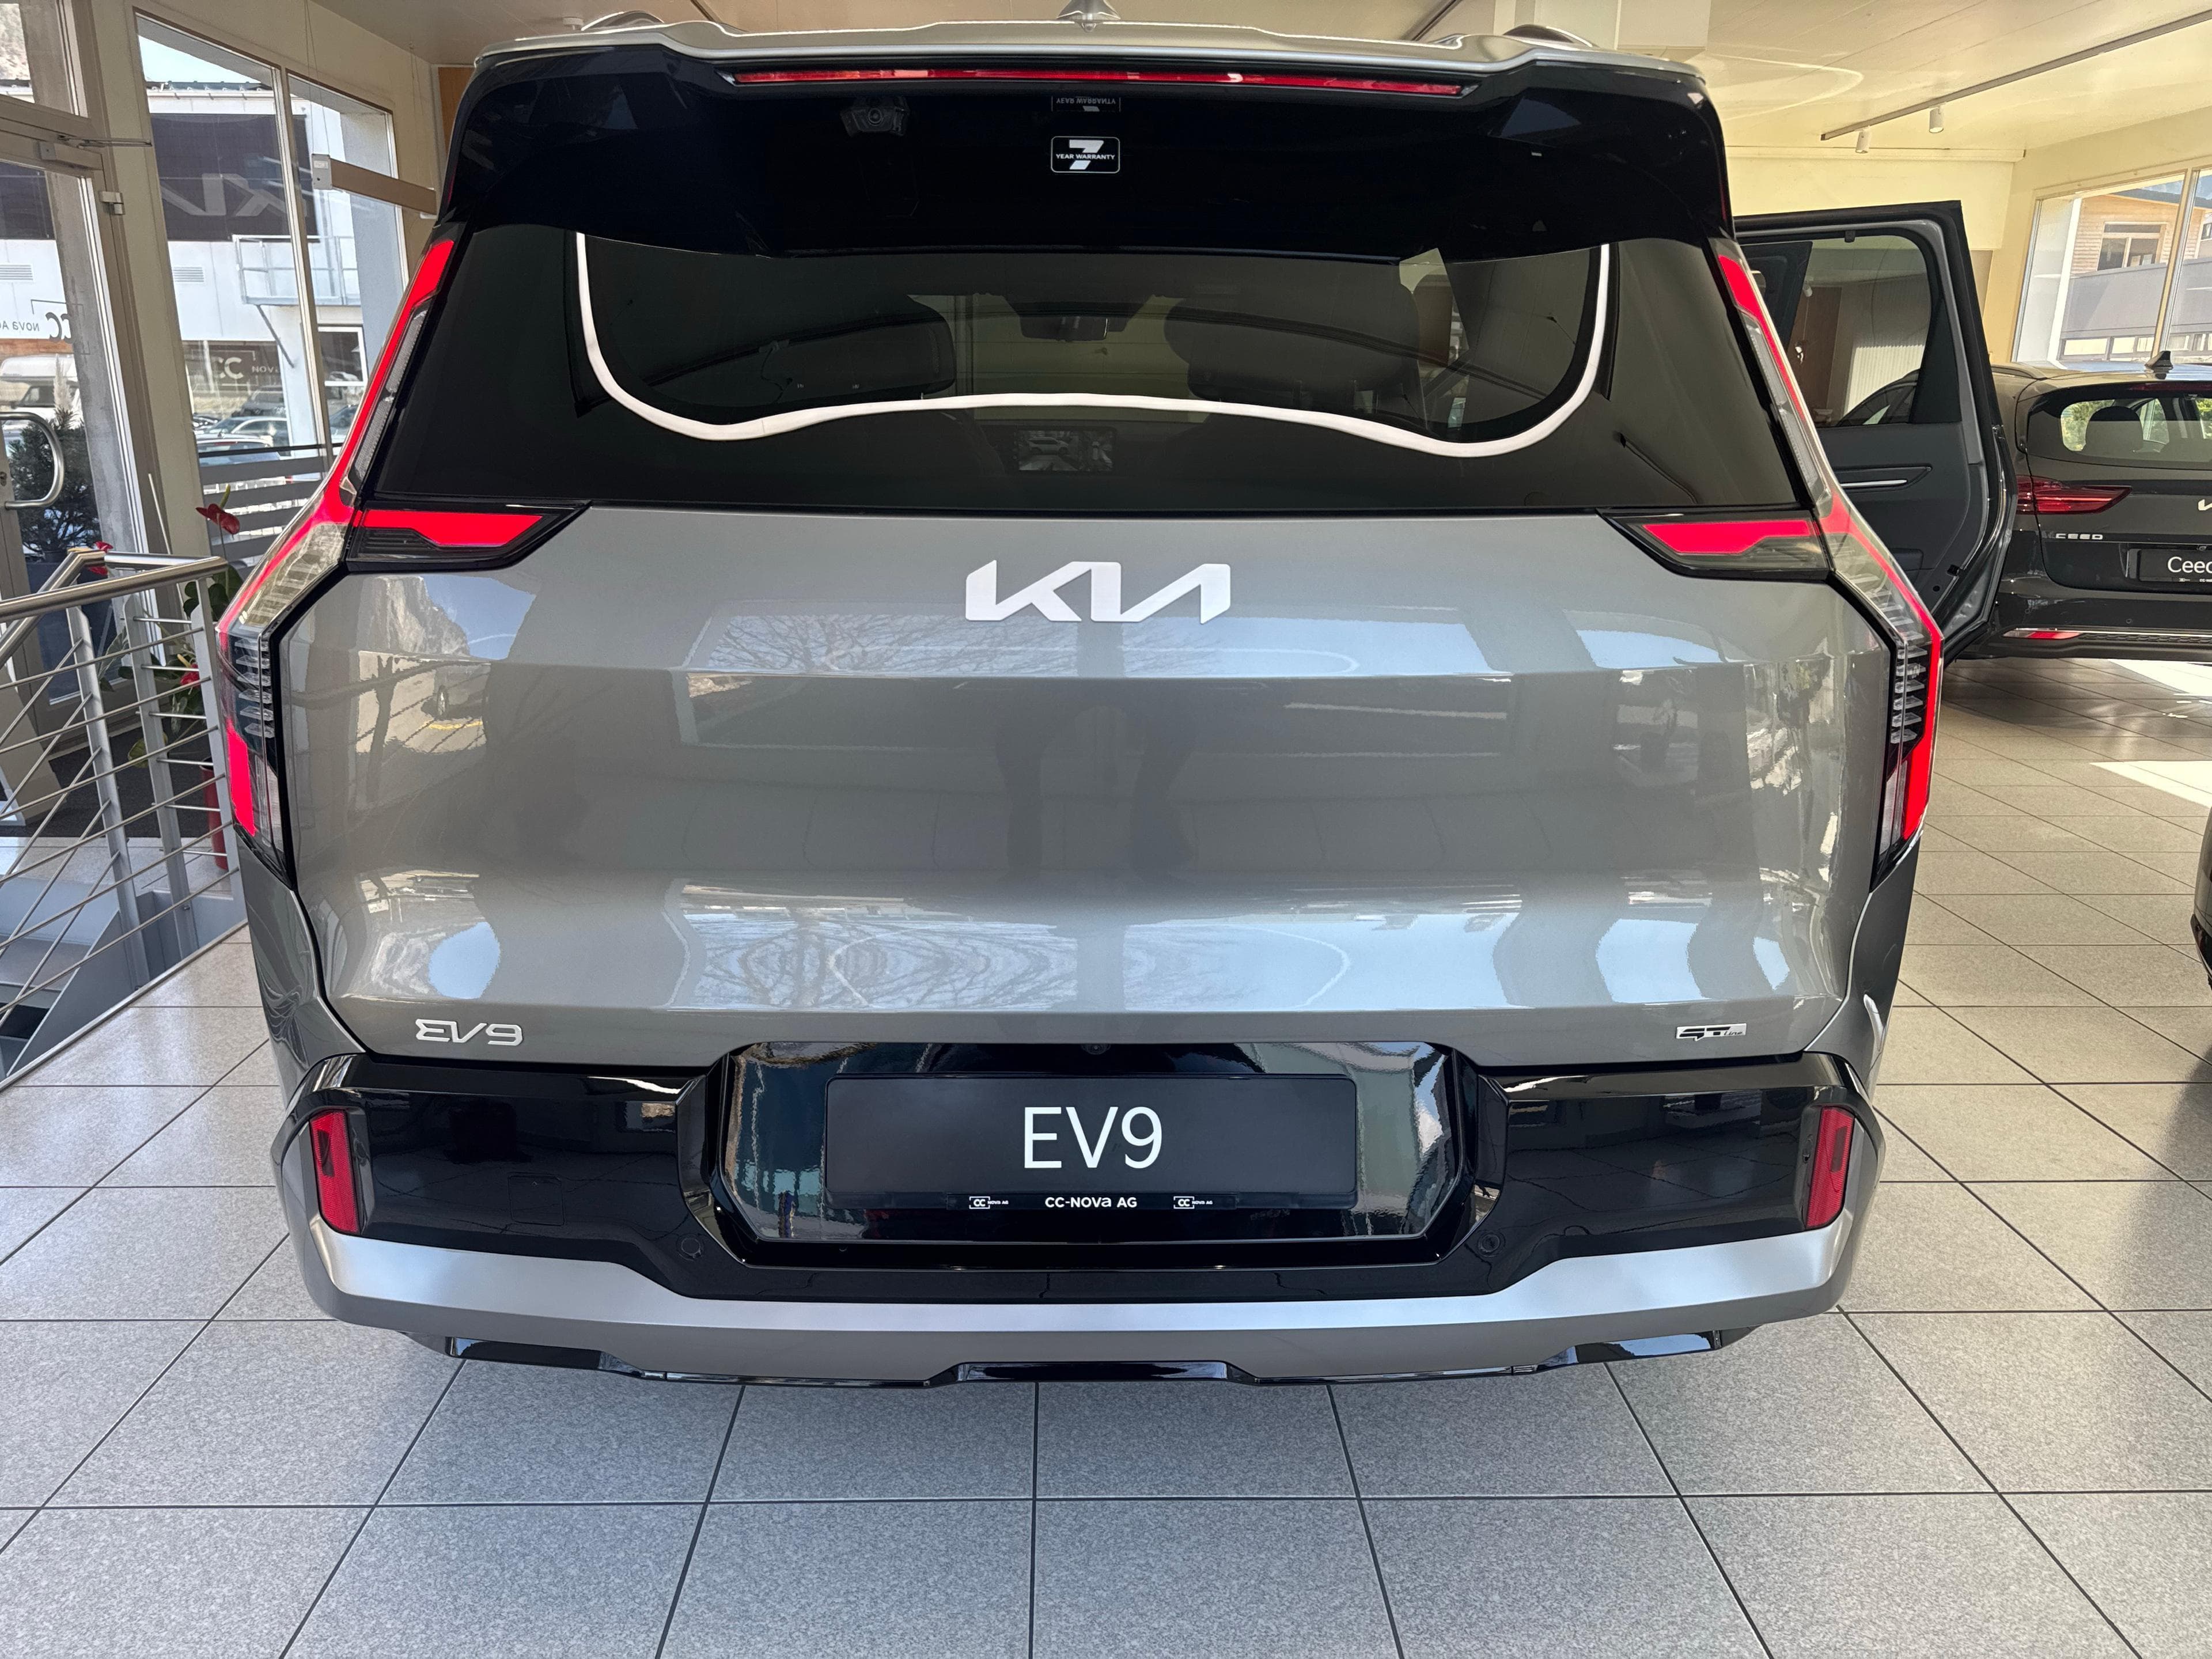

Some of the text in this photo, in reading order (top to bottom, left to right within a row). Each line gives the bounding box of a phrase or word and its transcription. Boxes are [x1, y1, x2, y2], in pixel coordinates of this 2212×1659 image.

[965, 560, 1230, 624] KIA
[415, 1018, 523, 1046] EV9
[1024, 1106, 1162, 1169] EV9
[973, 1199, 986, 1207] CC
[1116, 1196, 1137, 1208] AG
[1177, 1199, 1190, 1207] CC
